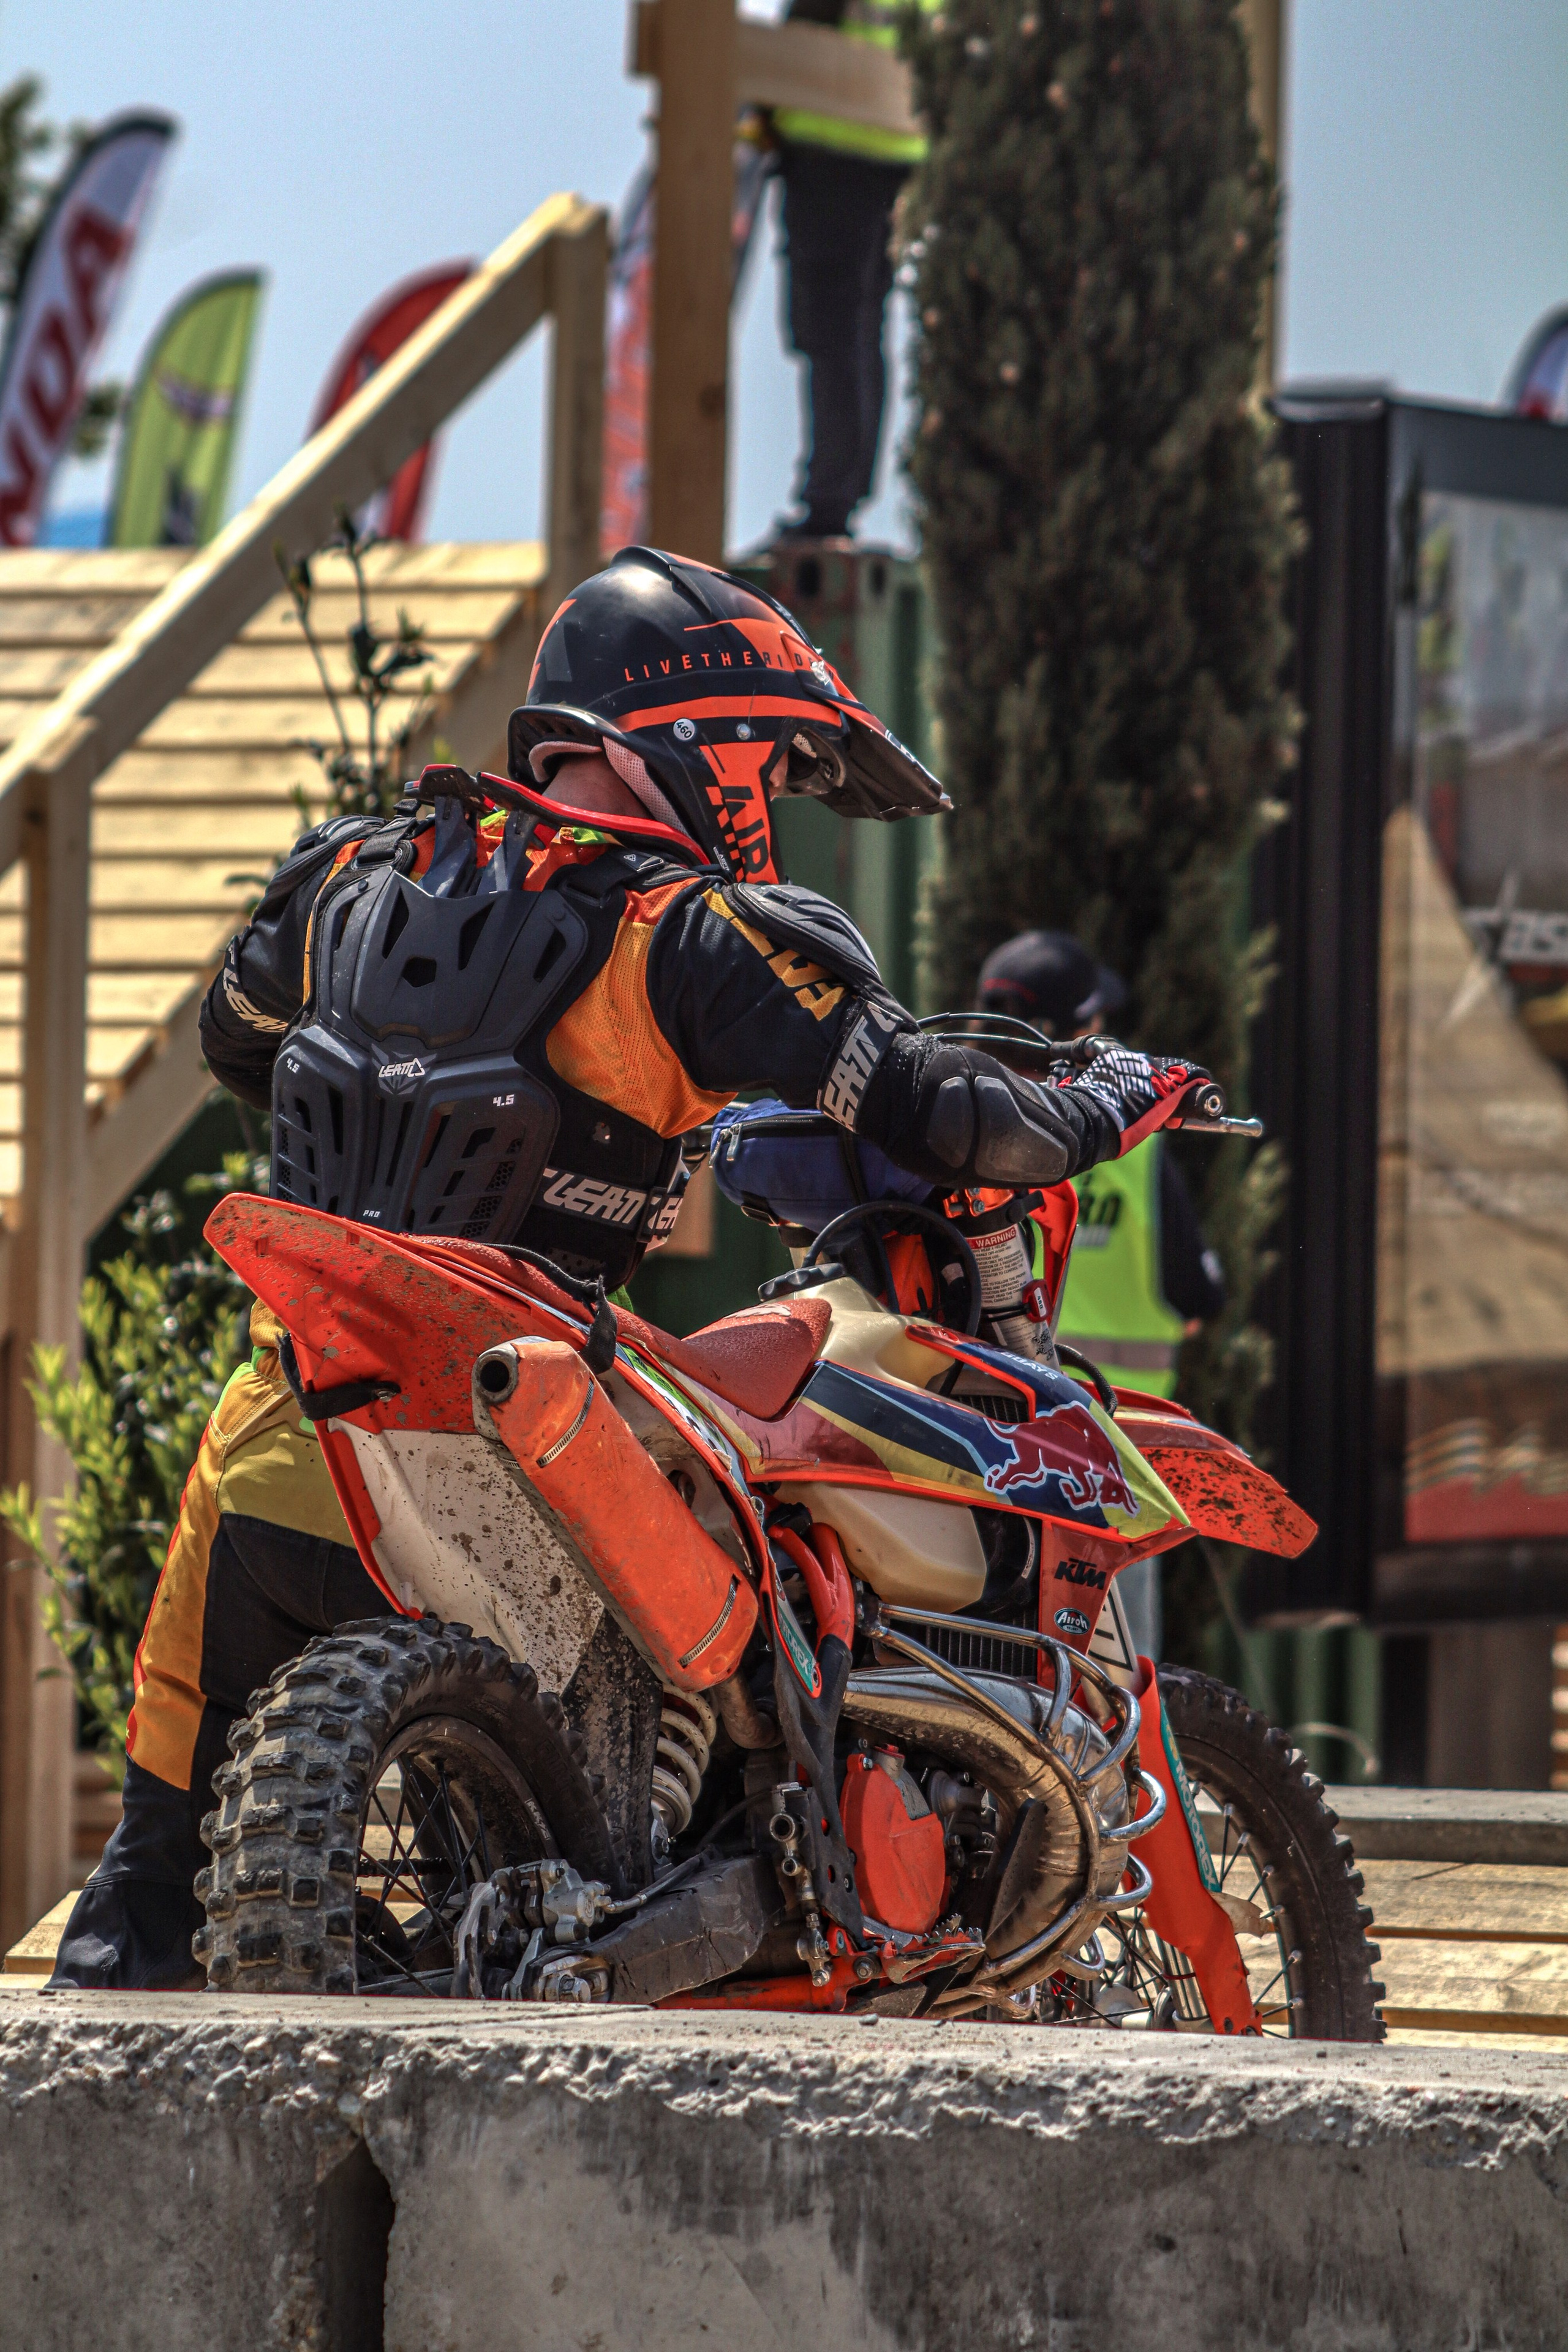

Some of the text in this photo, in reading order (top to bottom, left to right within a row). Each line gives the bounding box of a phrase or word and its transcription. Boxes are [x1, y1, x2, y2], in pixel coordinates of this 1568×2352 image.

[676, 721, 693, 739] 460
[706, 786, 769, 884] AIR
[286, 1057, 300, 1074] 4.5
[493, 1094, 514, 1107] 4.5
[543, 1173, 647, 1224] LEATT
[363, 1209, 380, 1218] PRO
[976, 1228, 1016, 1247] WARNING
[1054, 1558, 1107, 1590] KTM
[1057, 1611, 1088, 1629] Airoh
[1177, 1761, 1216, 1890] MOTOREX
